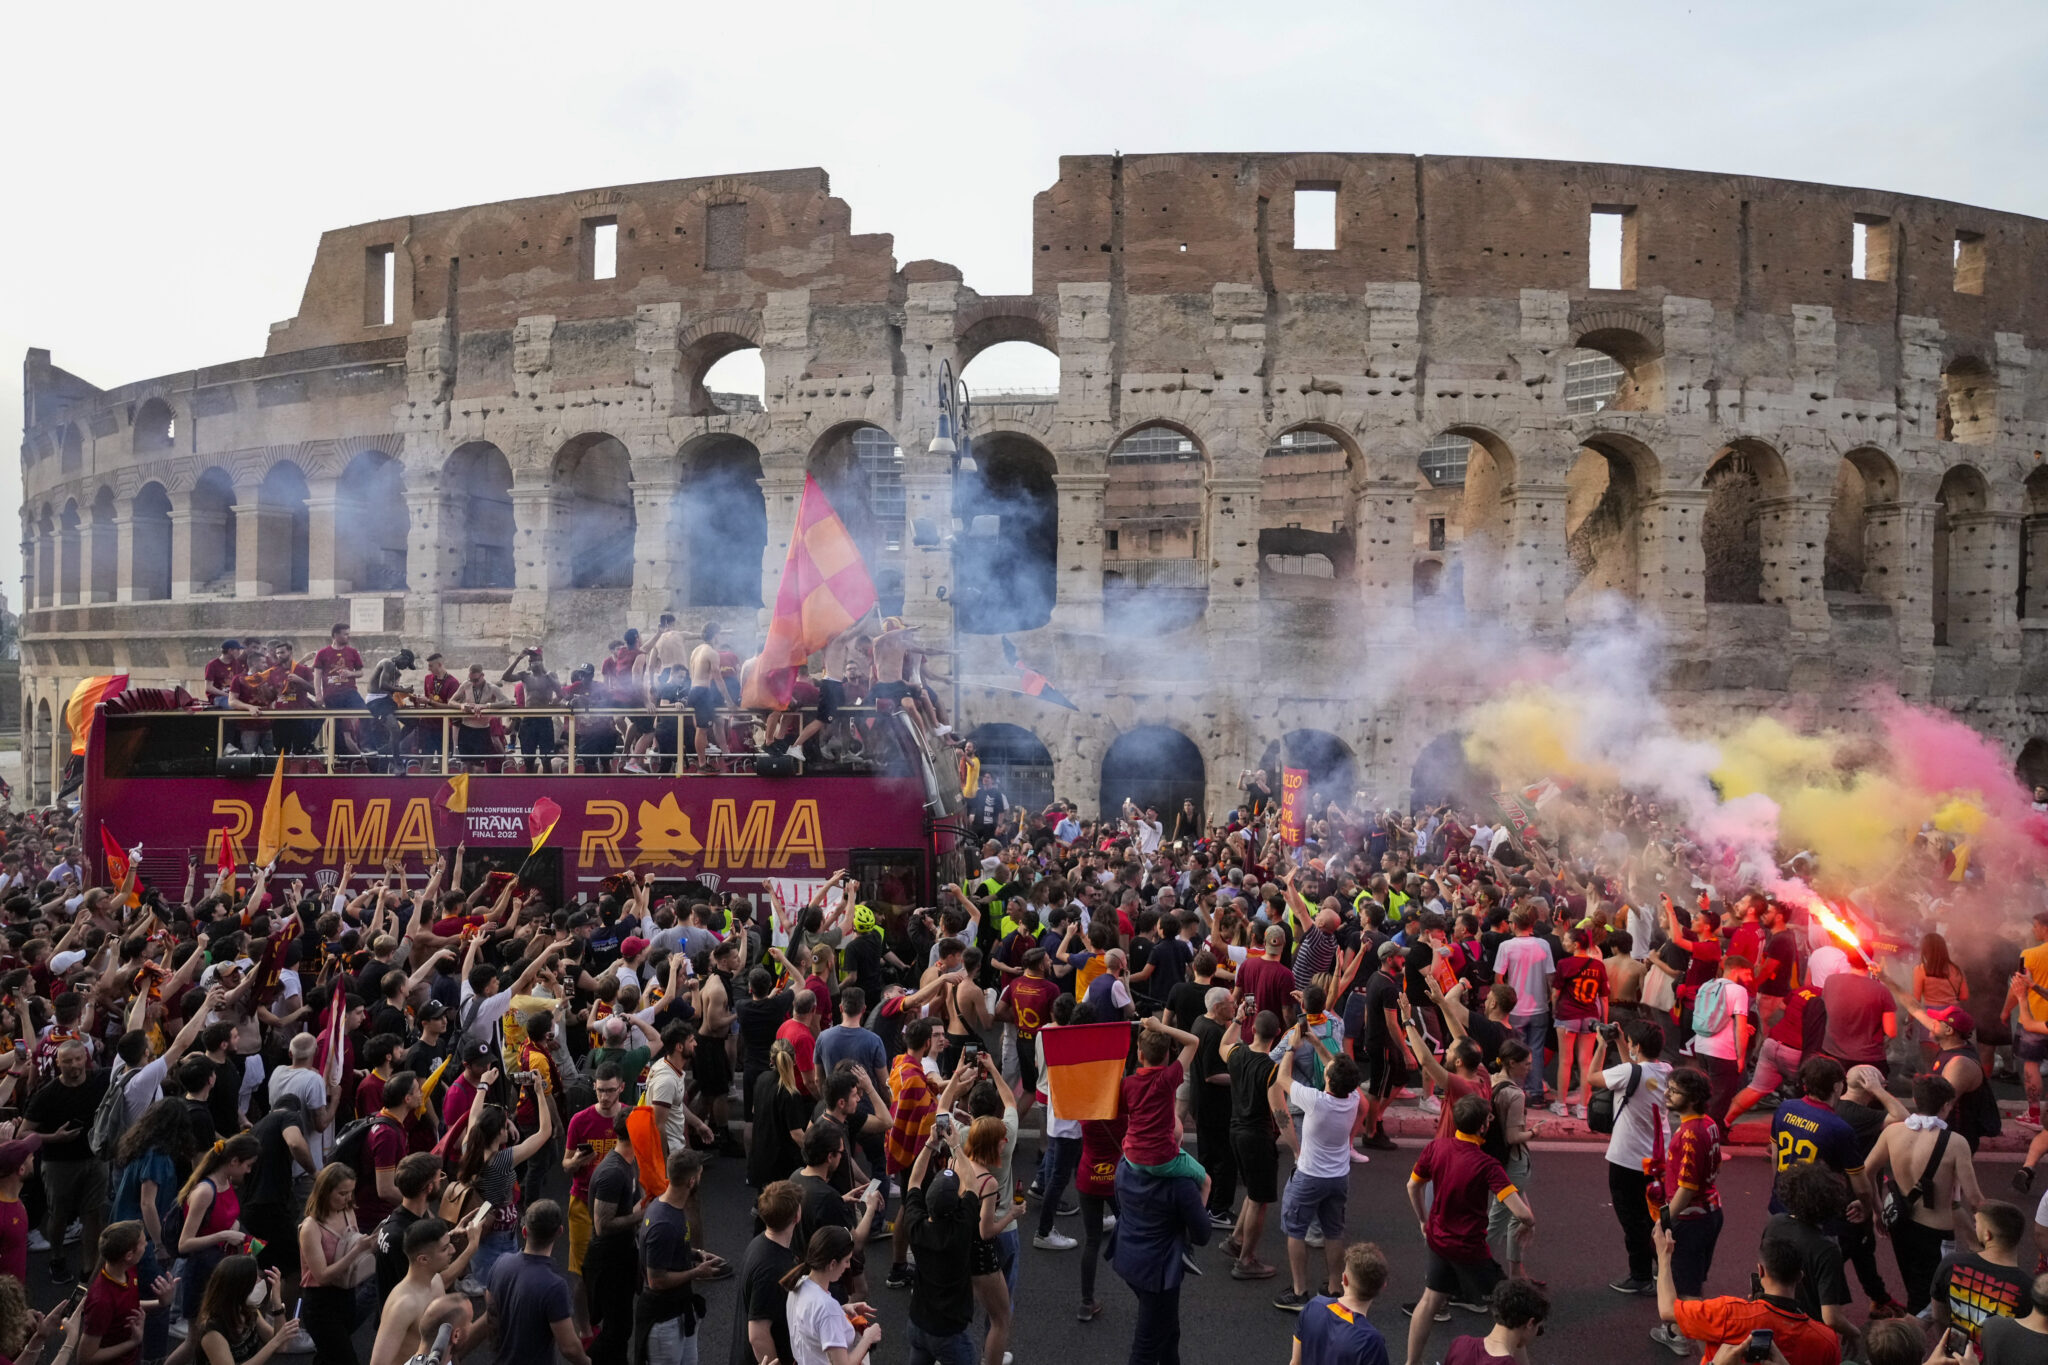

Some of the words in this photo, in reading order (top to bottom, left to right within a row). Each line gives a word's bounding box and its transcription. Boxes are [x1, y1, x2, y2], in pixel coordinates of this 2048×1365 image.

[466, 815, 523, 830] TIRANA
[1573, 978, 1599, 1004] 10
[1783, 1112, 1820, 1134] MANCINI
